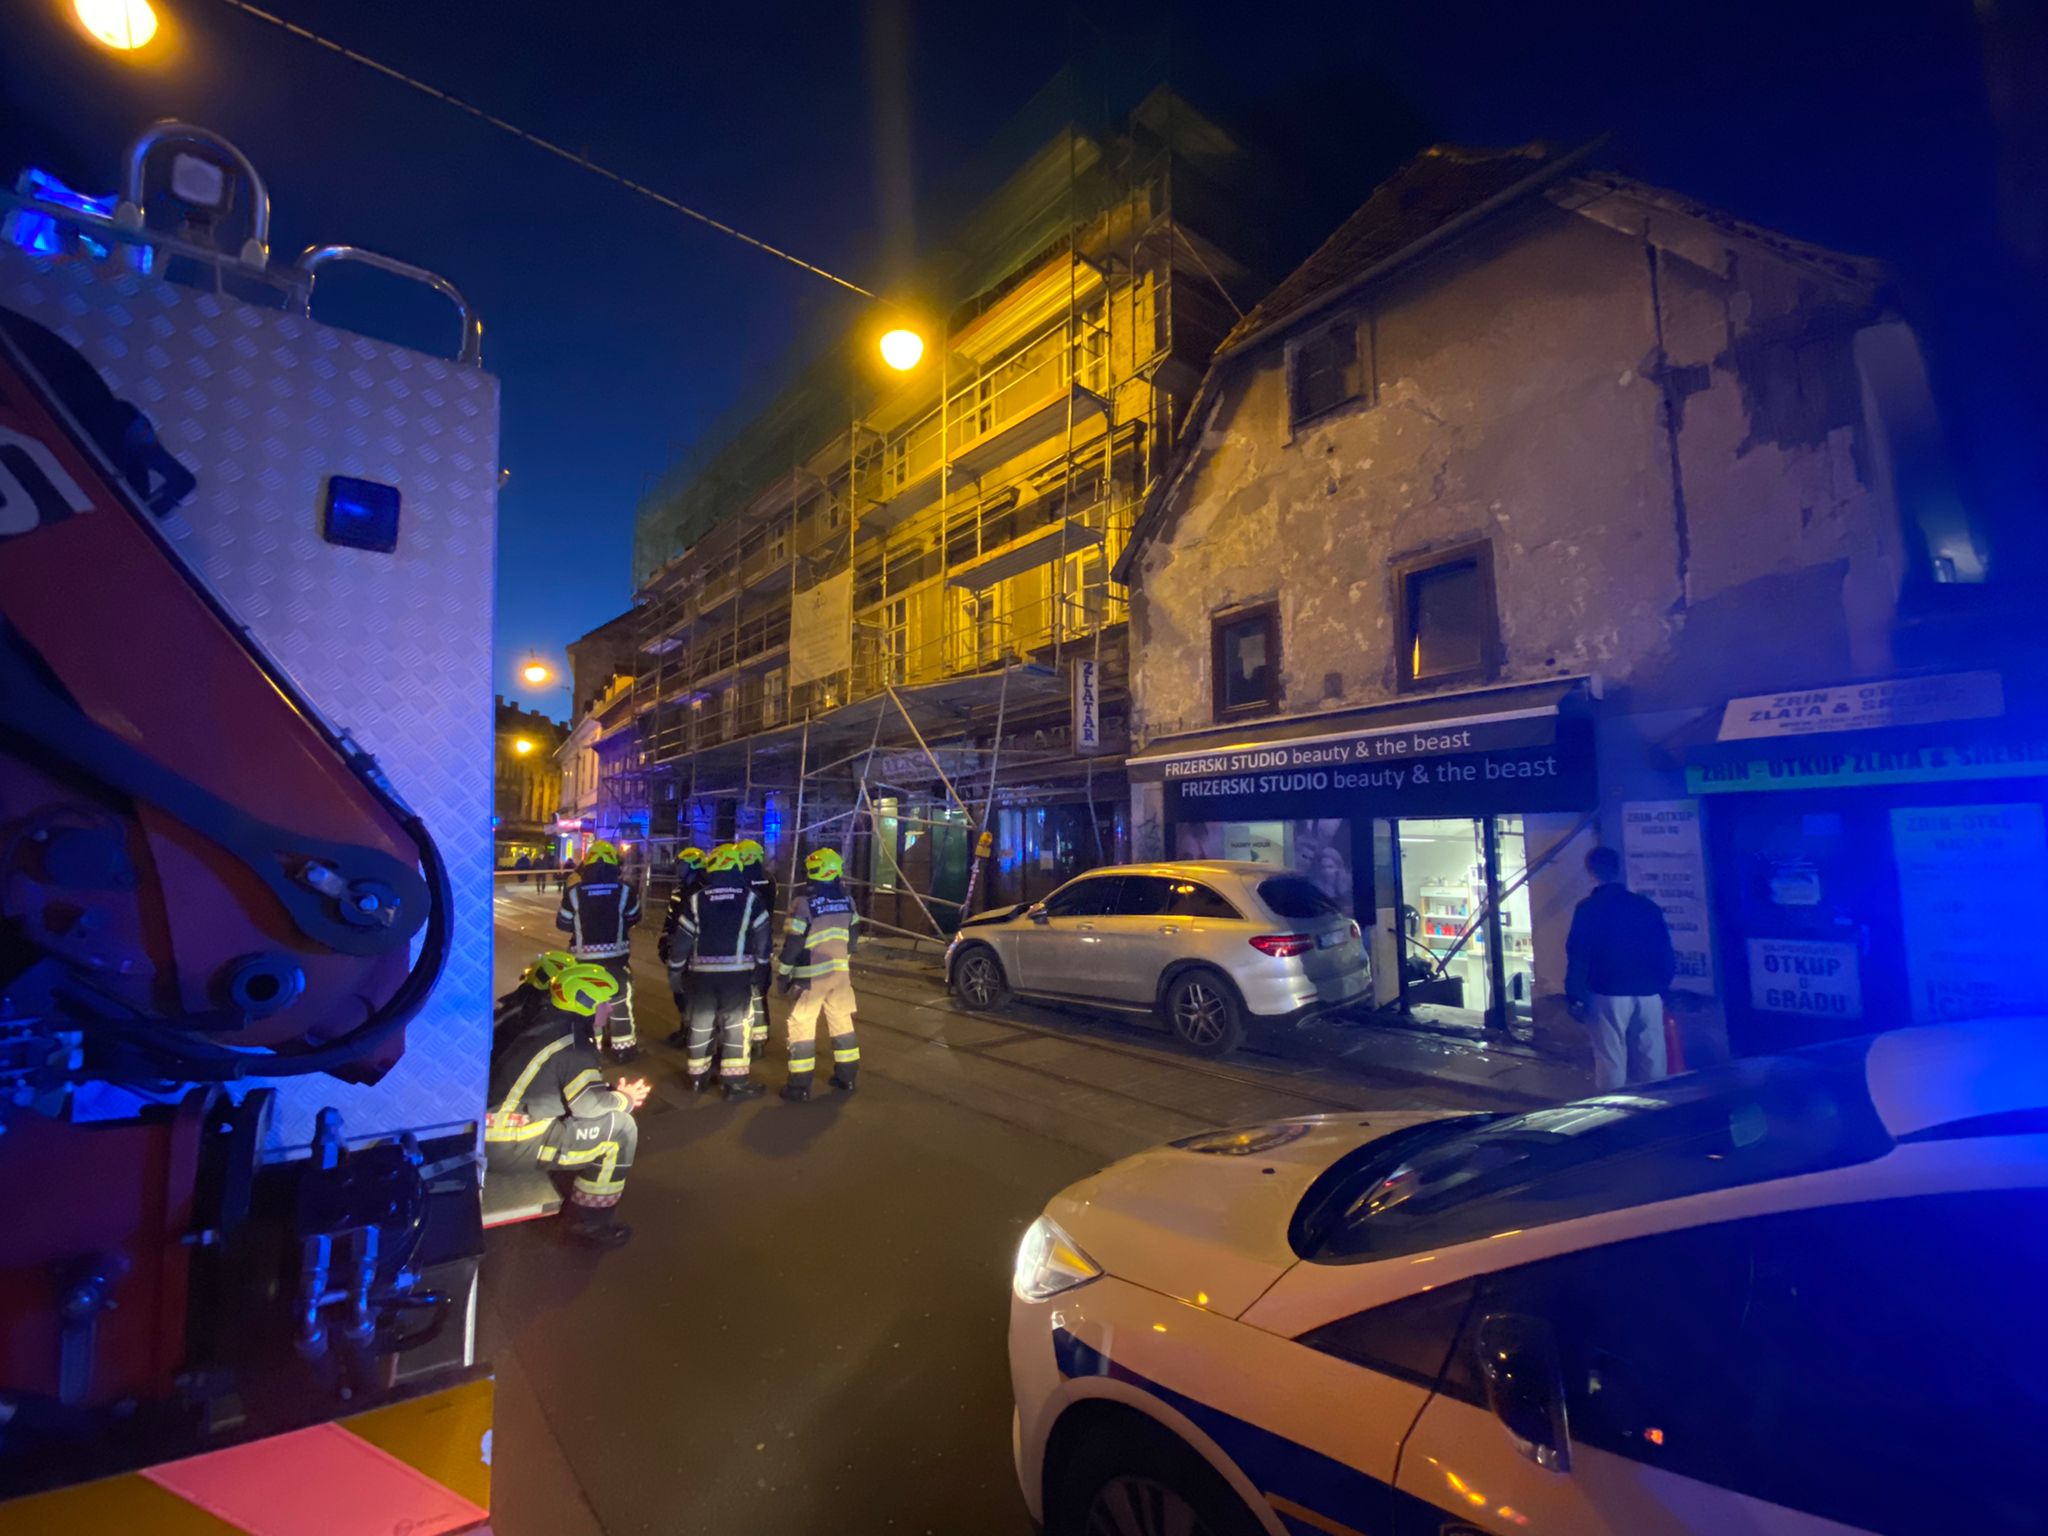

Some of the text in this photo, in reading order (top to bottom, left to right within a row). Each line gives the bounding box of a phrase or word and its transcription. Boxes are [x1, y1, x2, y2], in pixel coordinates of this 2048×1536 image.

[1082, 661, 1095, 741] ZLATAR
[1749, 704, 1822, 721] ZLATA
[1832, 702, 1850, 714] &
[1772, 692, 1829, 708] ZRIN
[1165, 731, 1470, 776] FRIZERSKI STUDIO beauty & the beast
[1703, 760, 1750, 782] ZRIN
[1769, 755, 1844, 778] OTKUP
[1852, 750, 1923, 773] ZLATA
[1182, 756, 1558, 797] FRIZERSKI STUDIO beauty & the beast
[1764, 954, 1841, 976] OTKUP
[1766, 988, 1847, 1013] GRADU
